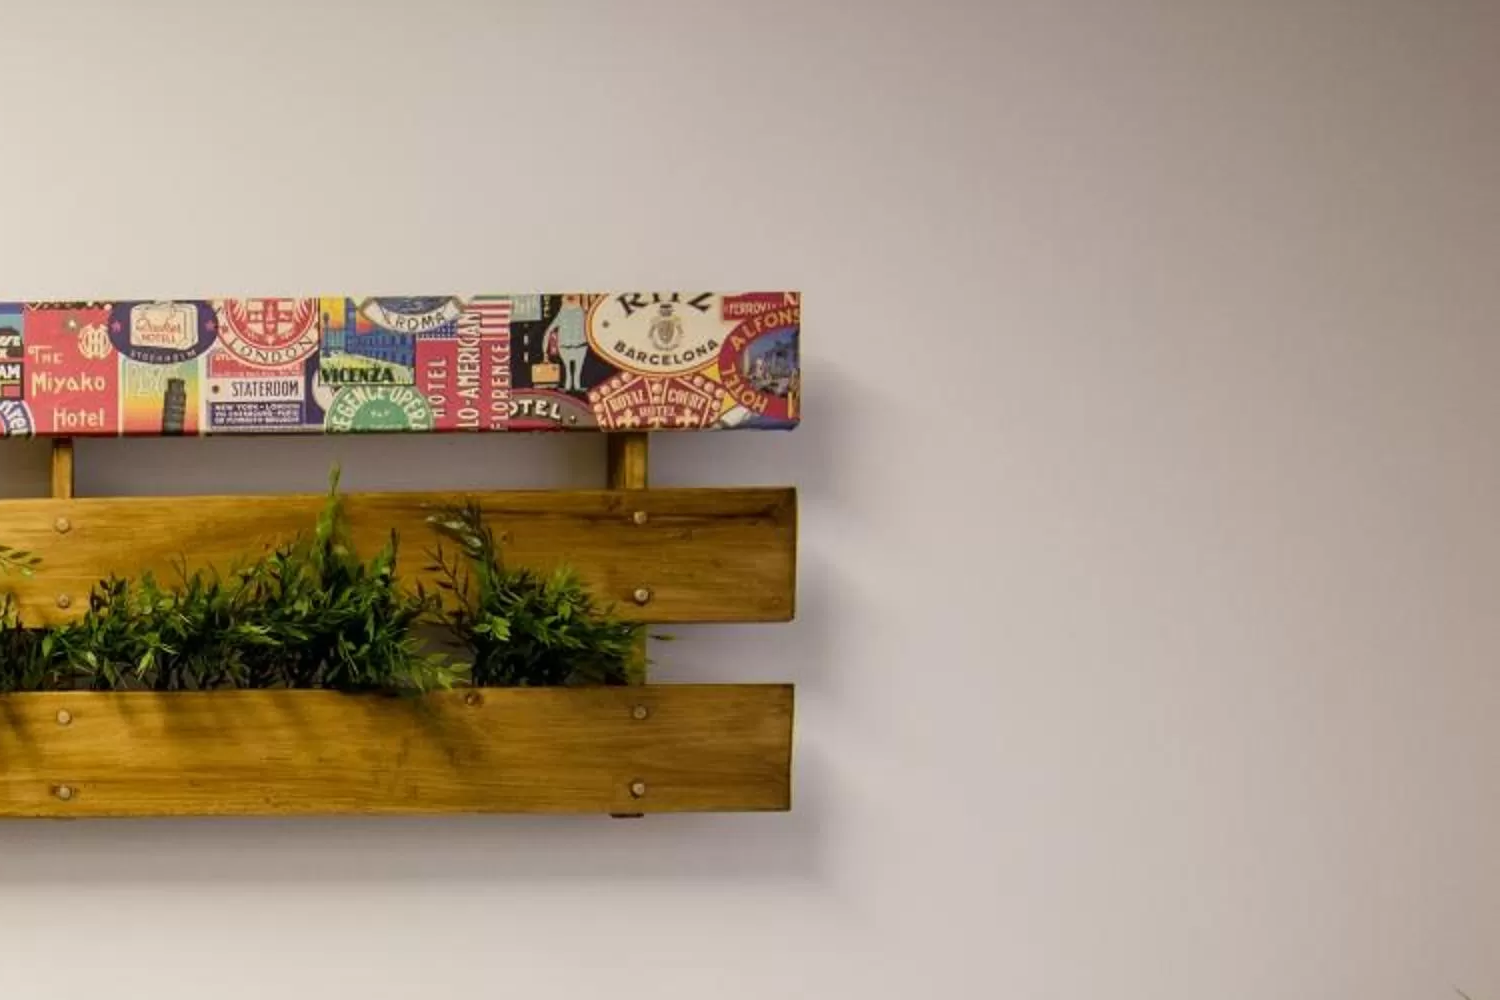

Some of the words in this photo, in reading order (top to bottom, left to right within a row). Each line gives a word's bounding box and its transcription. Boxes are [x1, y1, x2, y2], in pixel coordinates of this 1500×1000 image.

[395, 312, 446, 329] ROMA
[228, 335, 313, 363] LONDON
[613, 339, 719, 365] BARCELONA
[32, 371, 106, 398] Miyako
[231, 380, 299, 397] STATEROOM
[321, 367, 395, 384] VICENZA
[427, 359, 448, 418] HOTEL
[490, 343, 510, 430] FLORENCE
[721, 362, 769, 414] HOTEL
[52, 407, 105, 432] Hotel
